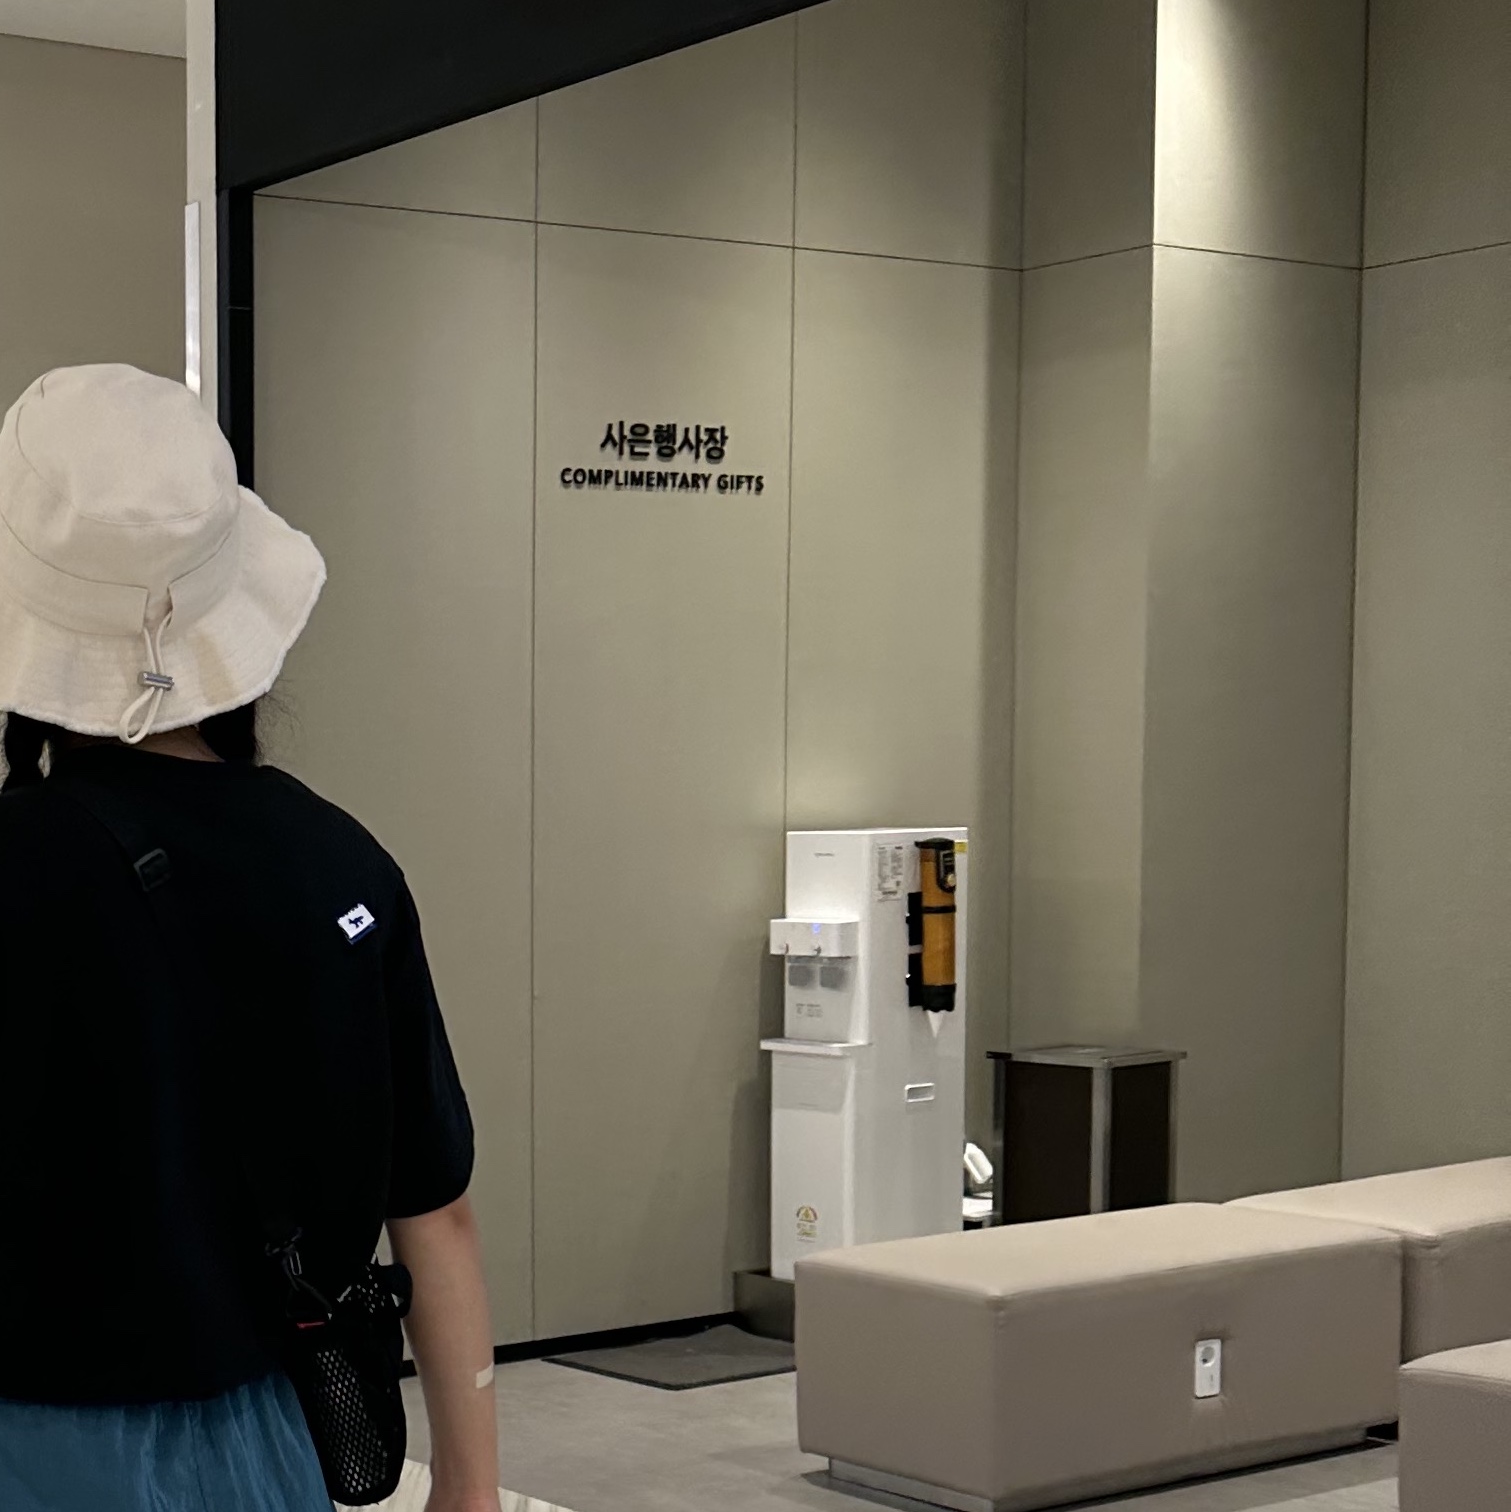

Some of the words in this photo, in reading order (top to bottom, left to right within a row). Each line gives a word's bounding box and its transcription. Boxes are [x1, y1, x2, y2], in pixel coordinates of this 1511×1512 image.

[600, 420, 729, 460] 사은행사장
[560, 467, 713, 490] COMPLIMENTARY
[716, 473, 765, 493] GIFTS
